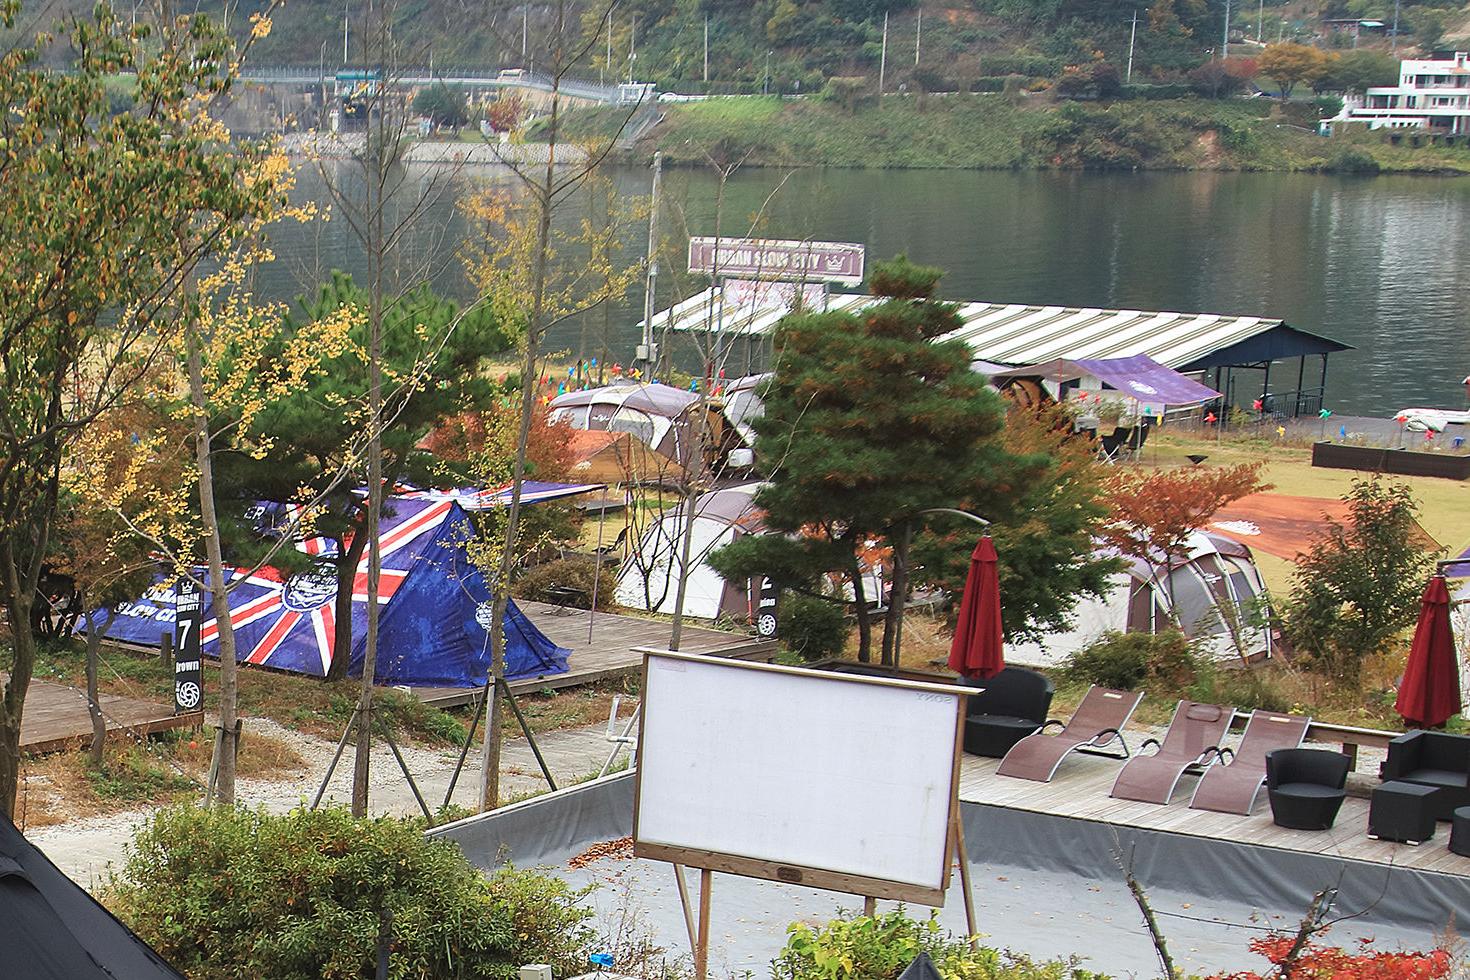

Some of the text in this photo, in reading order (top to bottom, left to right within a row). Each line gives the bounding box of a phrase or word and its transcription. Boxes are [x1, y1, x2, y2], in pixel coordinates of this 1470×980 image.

[711, 249, 821, 270] URBAN SLOW CITY
[178, 619, 192, 650] 7
